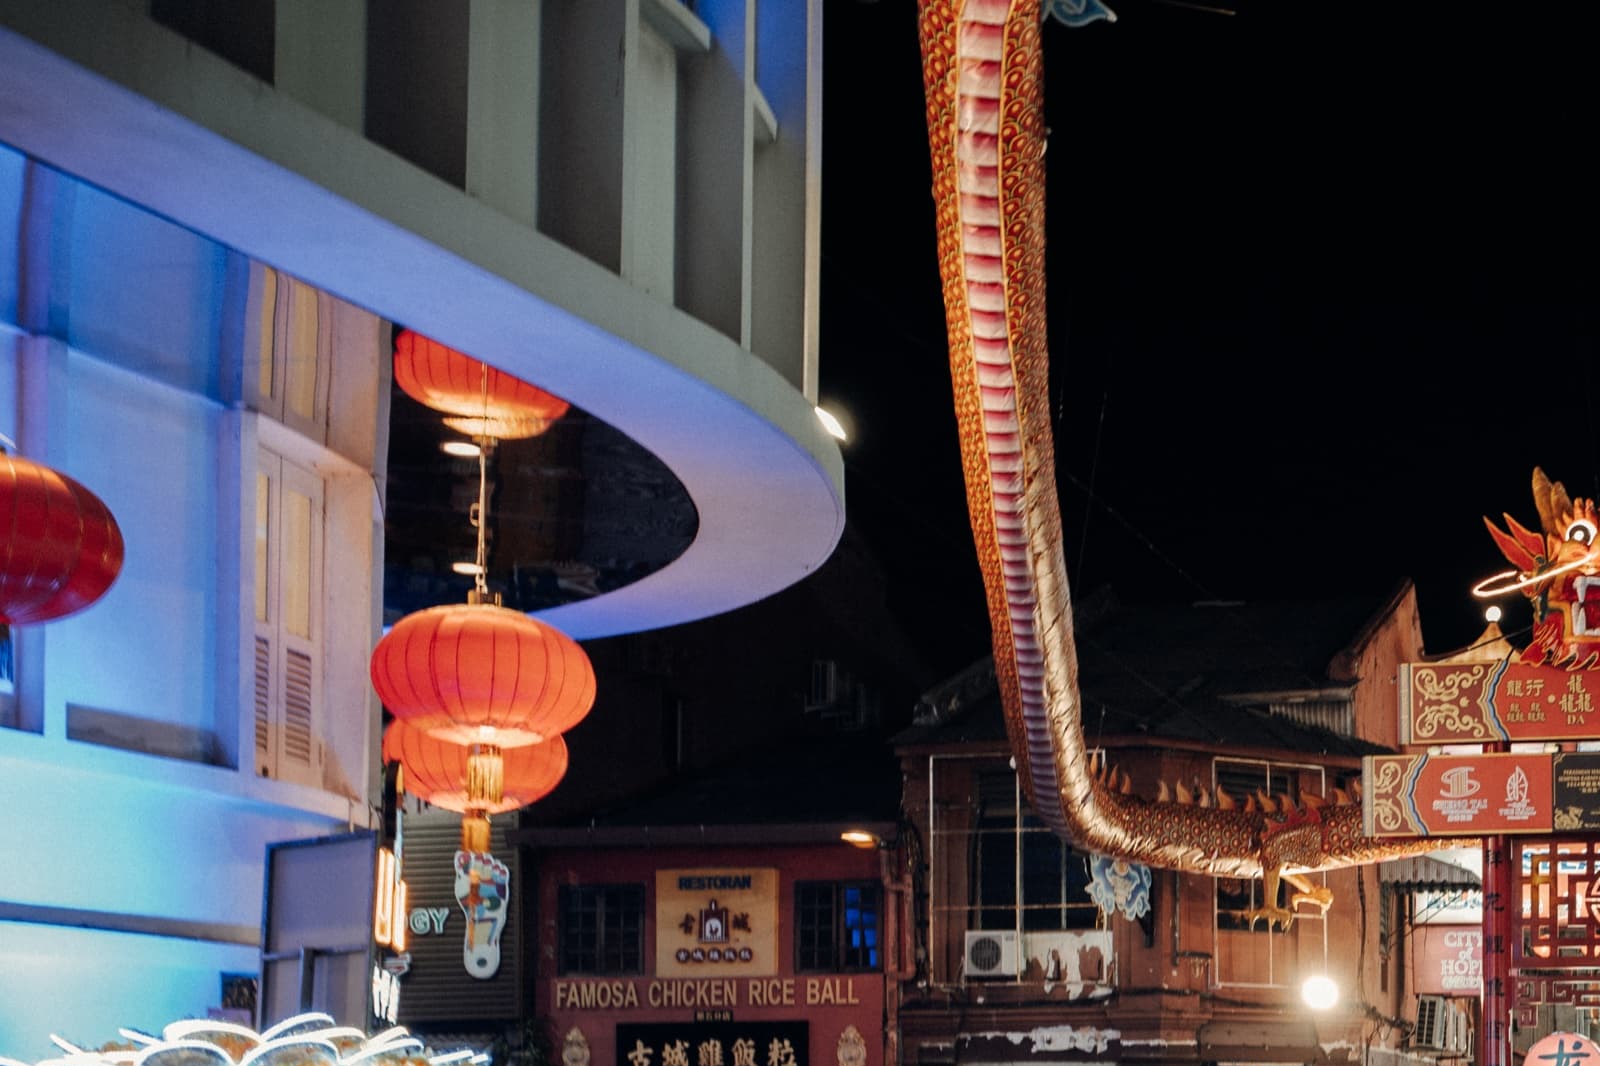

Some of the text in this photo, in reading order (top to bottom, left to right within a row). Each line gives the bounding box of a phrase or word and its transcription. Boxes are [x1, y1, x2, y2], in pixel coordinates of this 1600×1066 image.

[1506, 679, 1545, 698] 龍行
[1567, 713, 1585, 725] DA
[677, 874, 752, 892] RESTORAN
[1440, 960, 1483, 976] HOP
[556, 976, 860, 1009] FAMOSA CHICKEN RICE BALL
